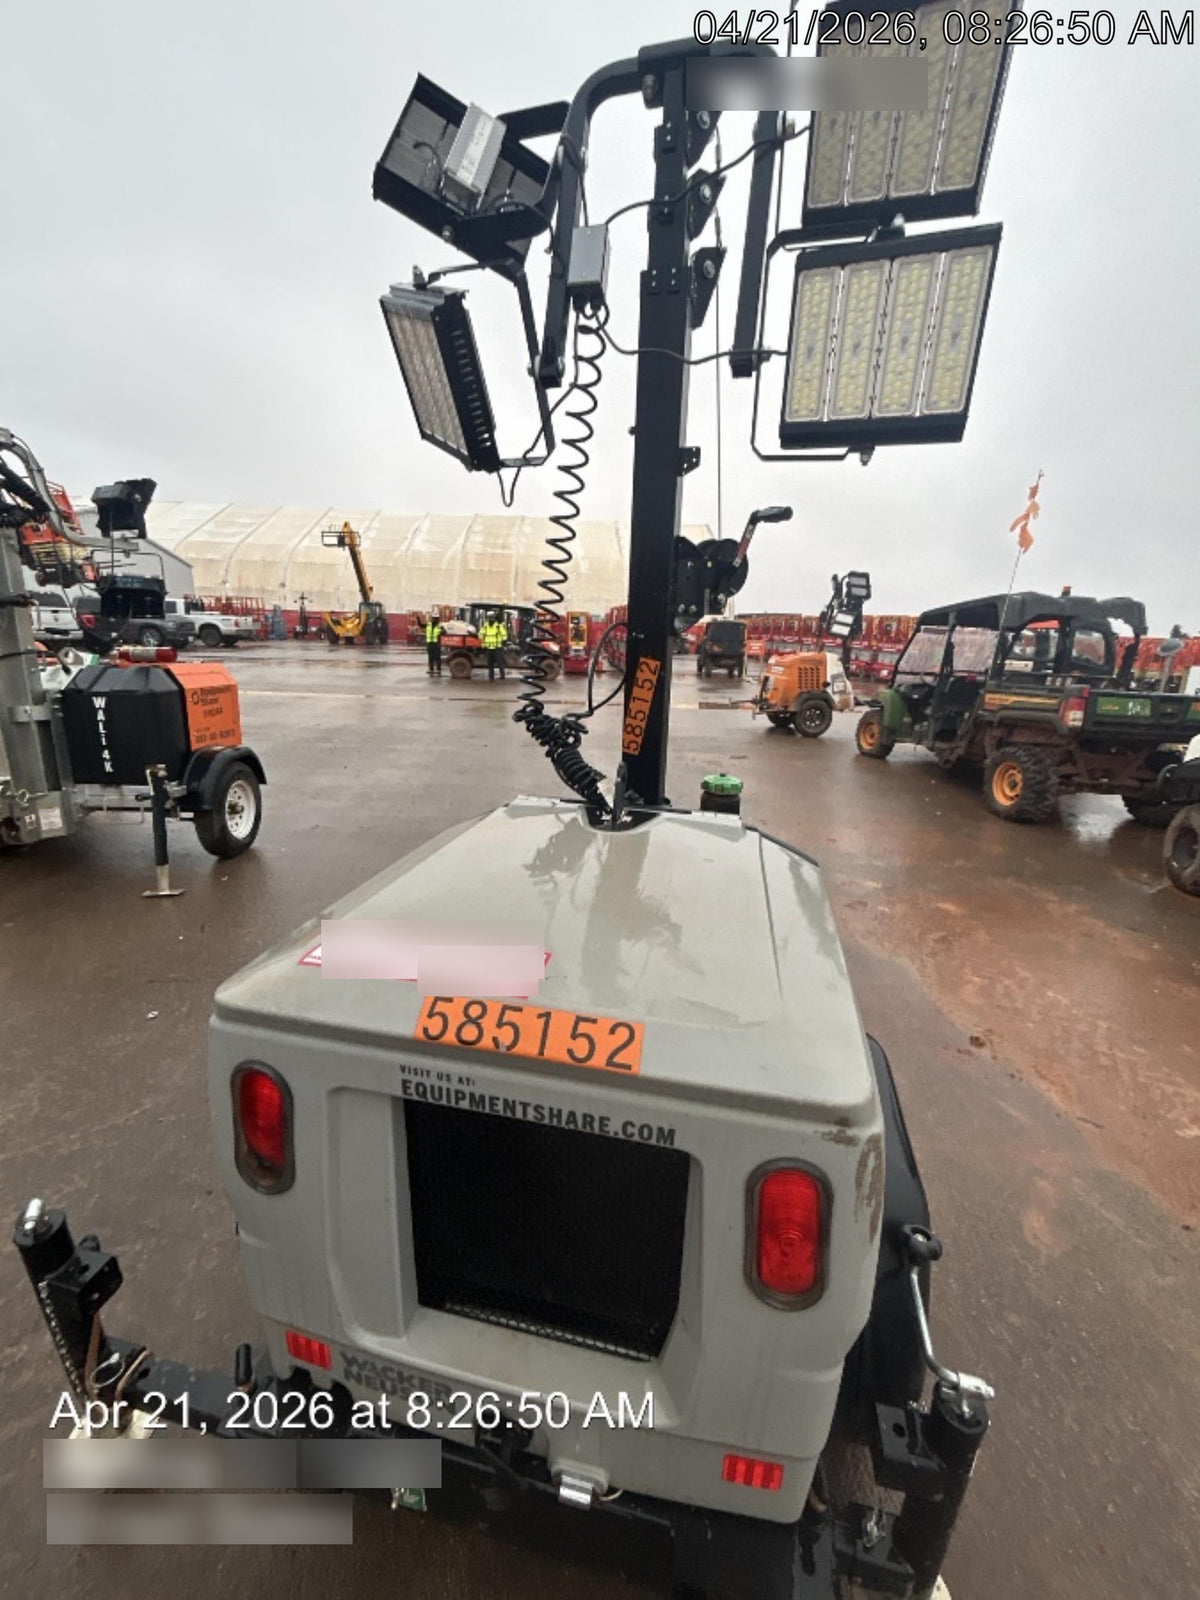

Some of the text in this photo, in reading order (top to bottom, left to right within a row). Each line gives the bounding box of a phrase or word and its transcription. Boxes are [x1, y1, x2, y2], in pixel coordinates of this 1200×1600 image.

[623, 661, 660, 752] 585152
[421, 996, 637, 1071] 585152
[400, 1064, 475, 1087] VISIT US AT:
[401, 1078, 677, 1146] EQUIPMENTSHARE.COM
[340, 1351, 454, 1400] WACKER
